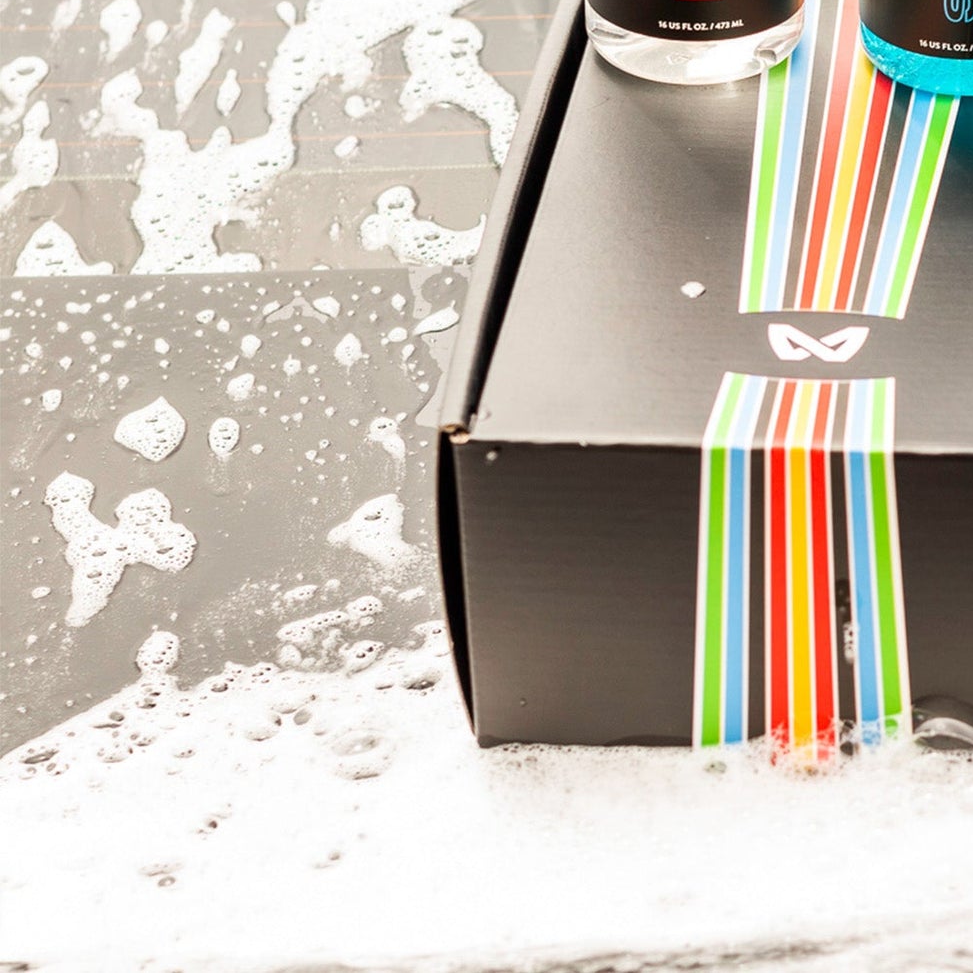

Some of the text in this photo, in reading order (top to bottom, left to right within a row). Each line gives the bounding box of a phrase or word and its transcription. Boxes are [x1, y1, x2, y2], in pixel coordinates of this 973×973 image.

[658, 20, 667, 29] 16
[668, 21, 680, 30] US
[715, 21, 730, 30] 473
[731, 19, 744, 28] ML
[919, 39, 928, 48] 16
[929, 41, 940, 49] US
